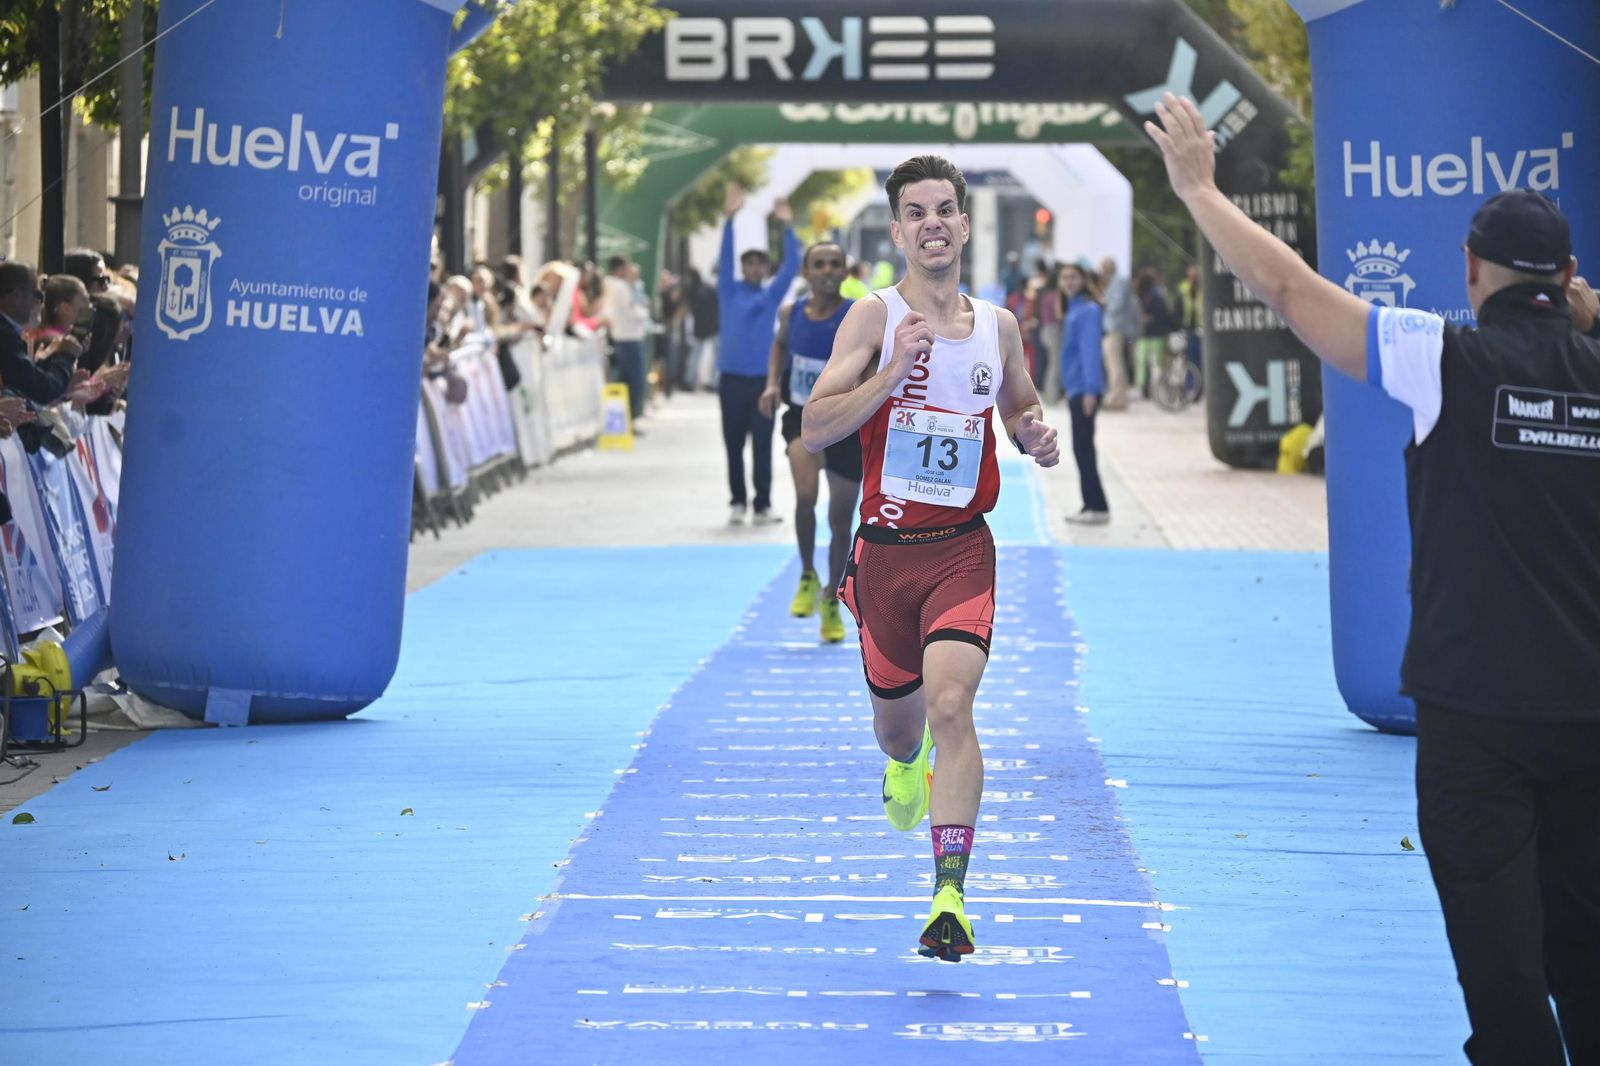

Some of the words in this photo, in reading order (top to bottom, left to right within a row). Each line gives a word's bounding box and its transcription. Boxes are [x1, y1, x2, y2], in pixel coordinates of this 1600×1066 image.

[167, 106, 399, 178] Huelva
[1343, 132, 1574, 197] Huelva
[298, 181, 377, 208] original
[229, 278, 345, 300] Ayuntamiento
[348, 286, 368, 302] de
[225, 300, 364, 337] HUELVA
[1508, 393, 1554, 420] MARKER
[916, 435, 959, 471] 13
[907, 480, 955, 497] Huelva
[940, 828, 966, 838] KEEP
[940, 836, 964, 845] CALM
